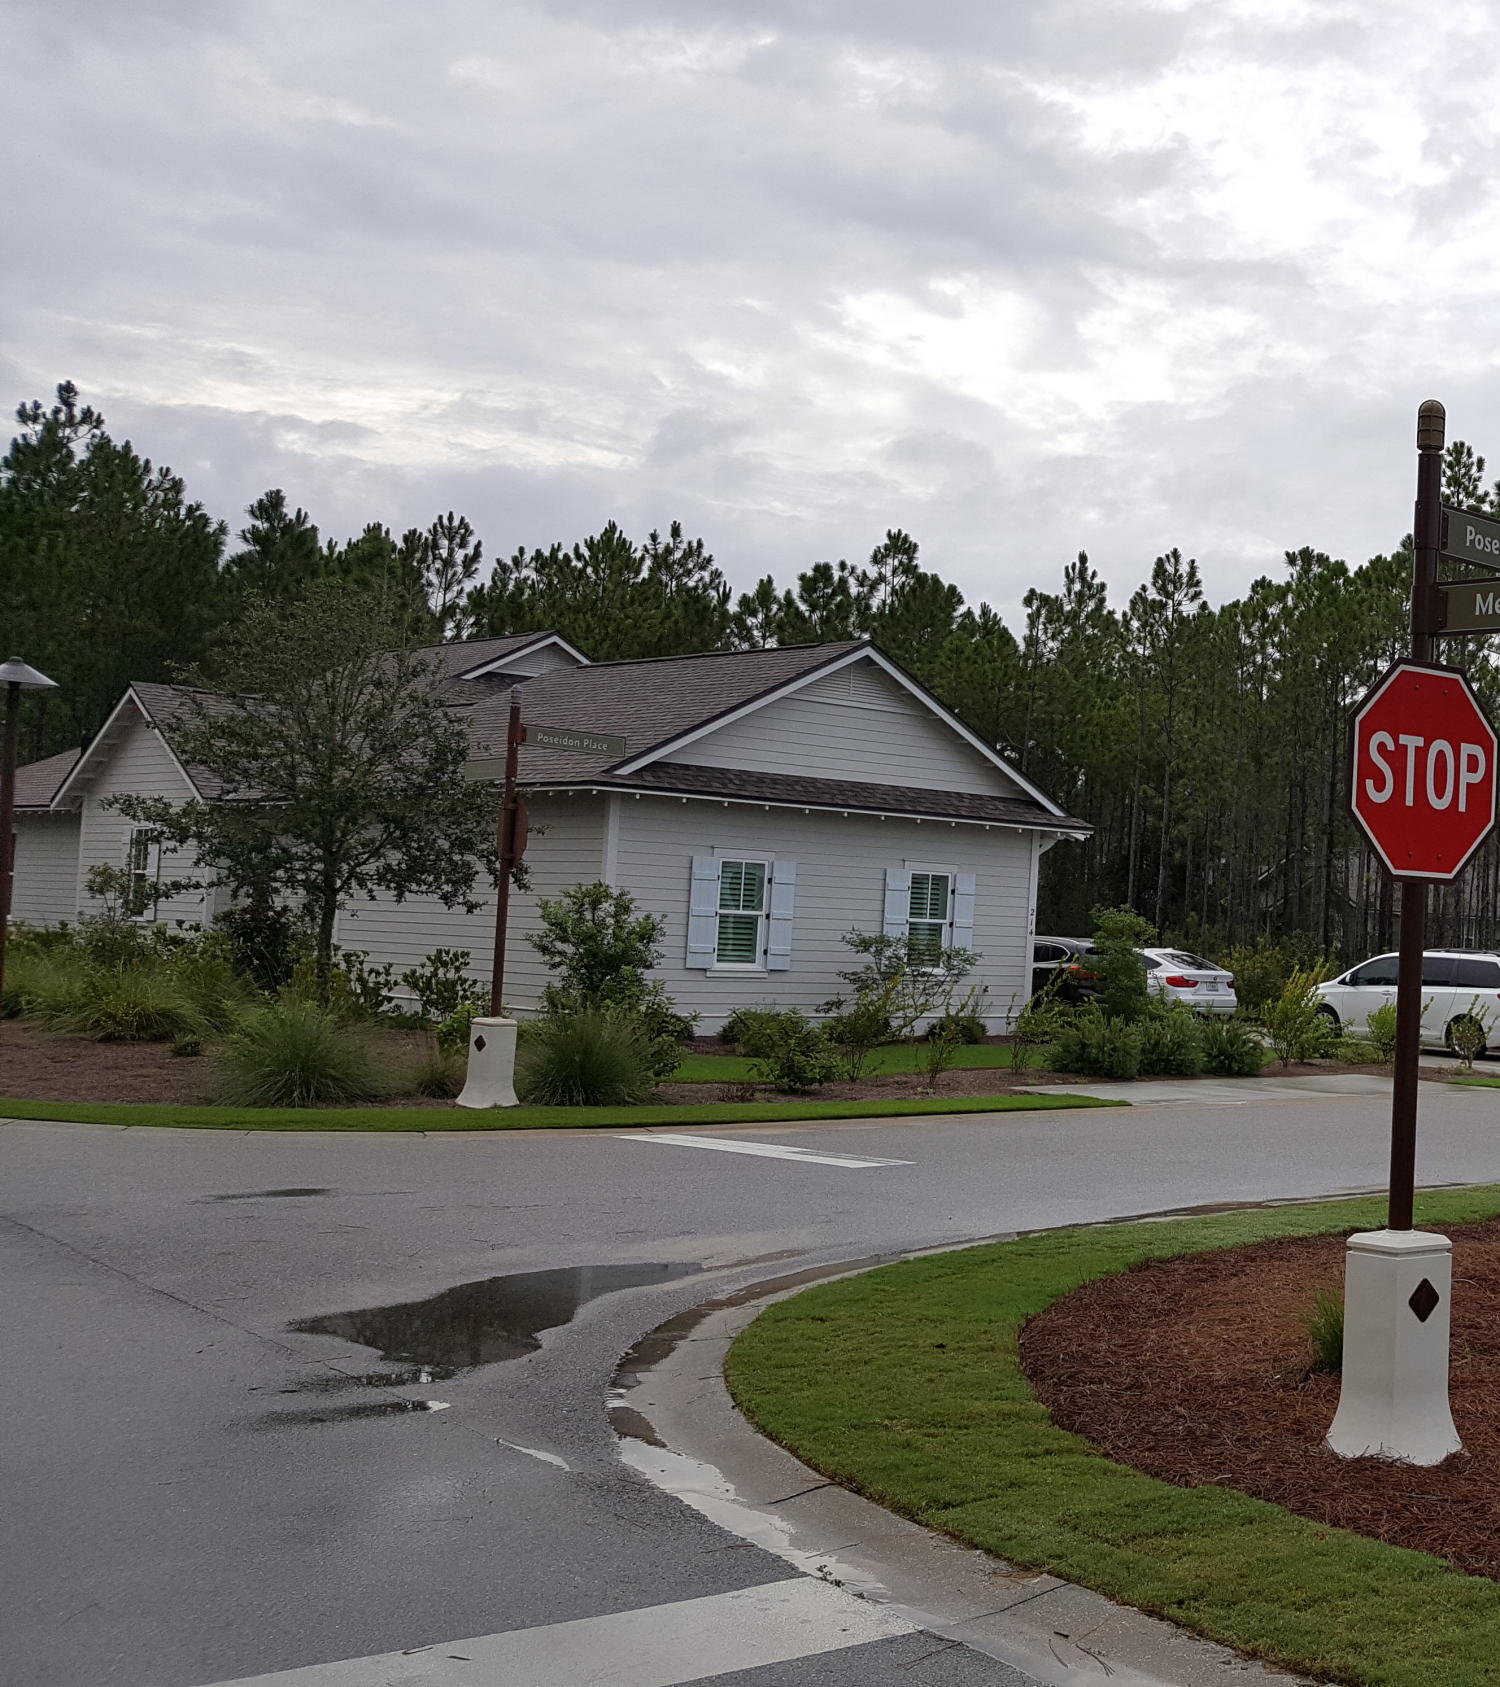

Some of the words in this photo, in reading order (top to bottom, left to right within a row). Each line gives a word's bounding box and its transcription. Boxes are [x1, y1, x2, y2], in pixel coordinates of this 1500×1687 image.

[537, 732, 580, 748] Poseidon
[583, 738, 608, 751] Place
[1365, 730, 1486, 813] STOP
